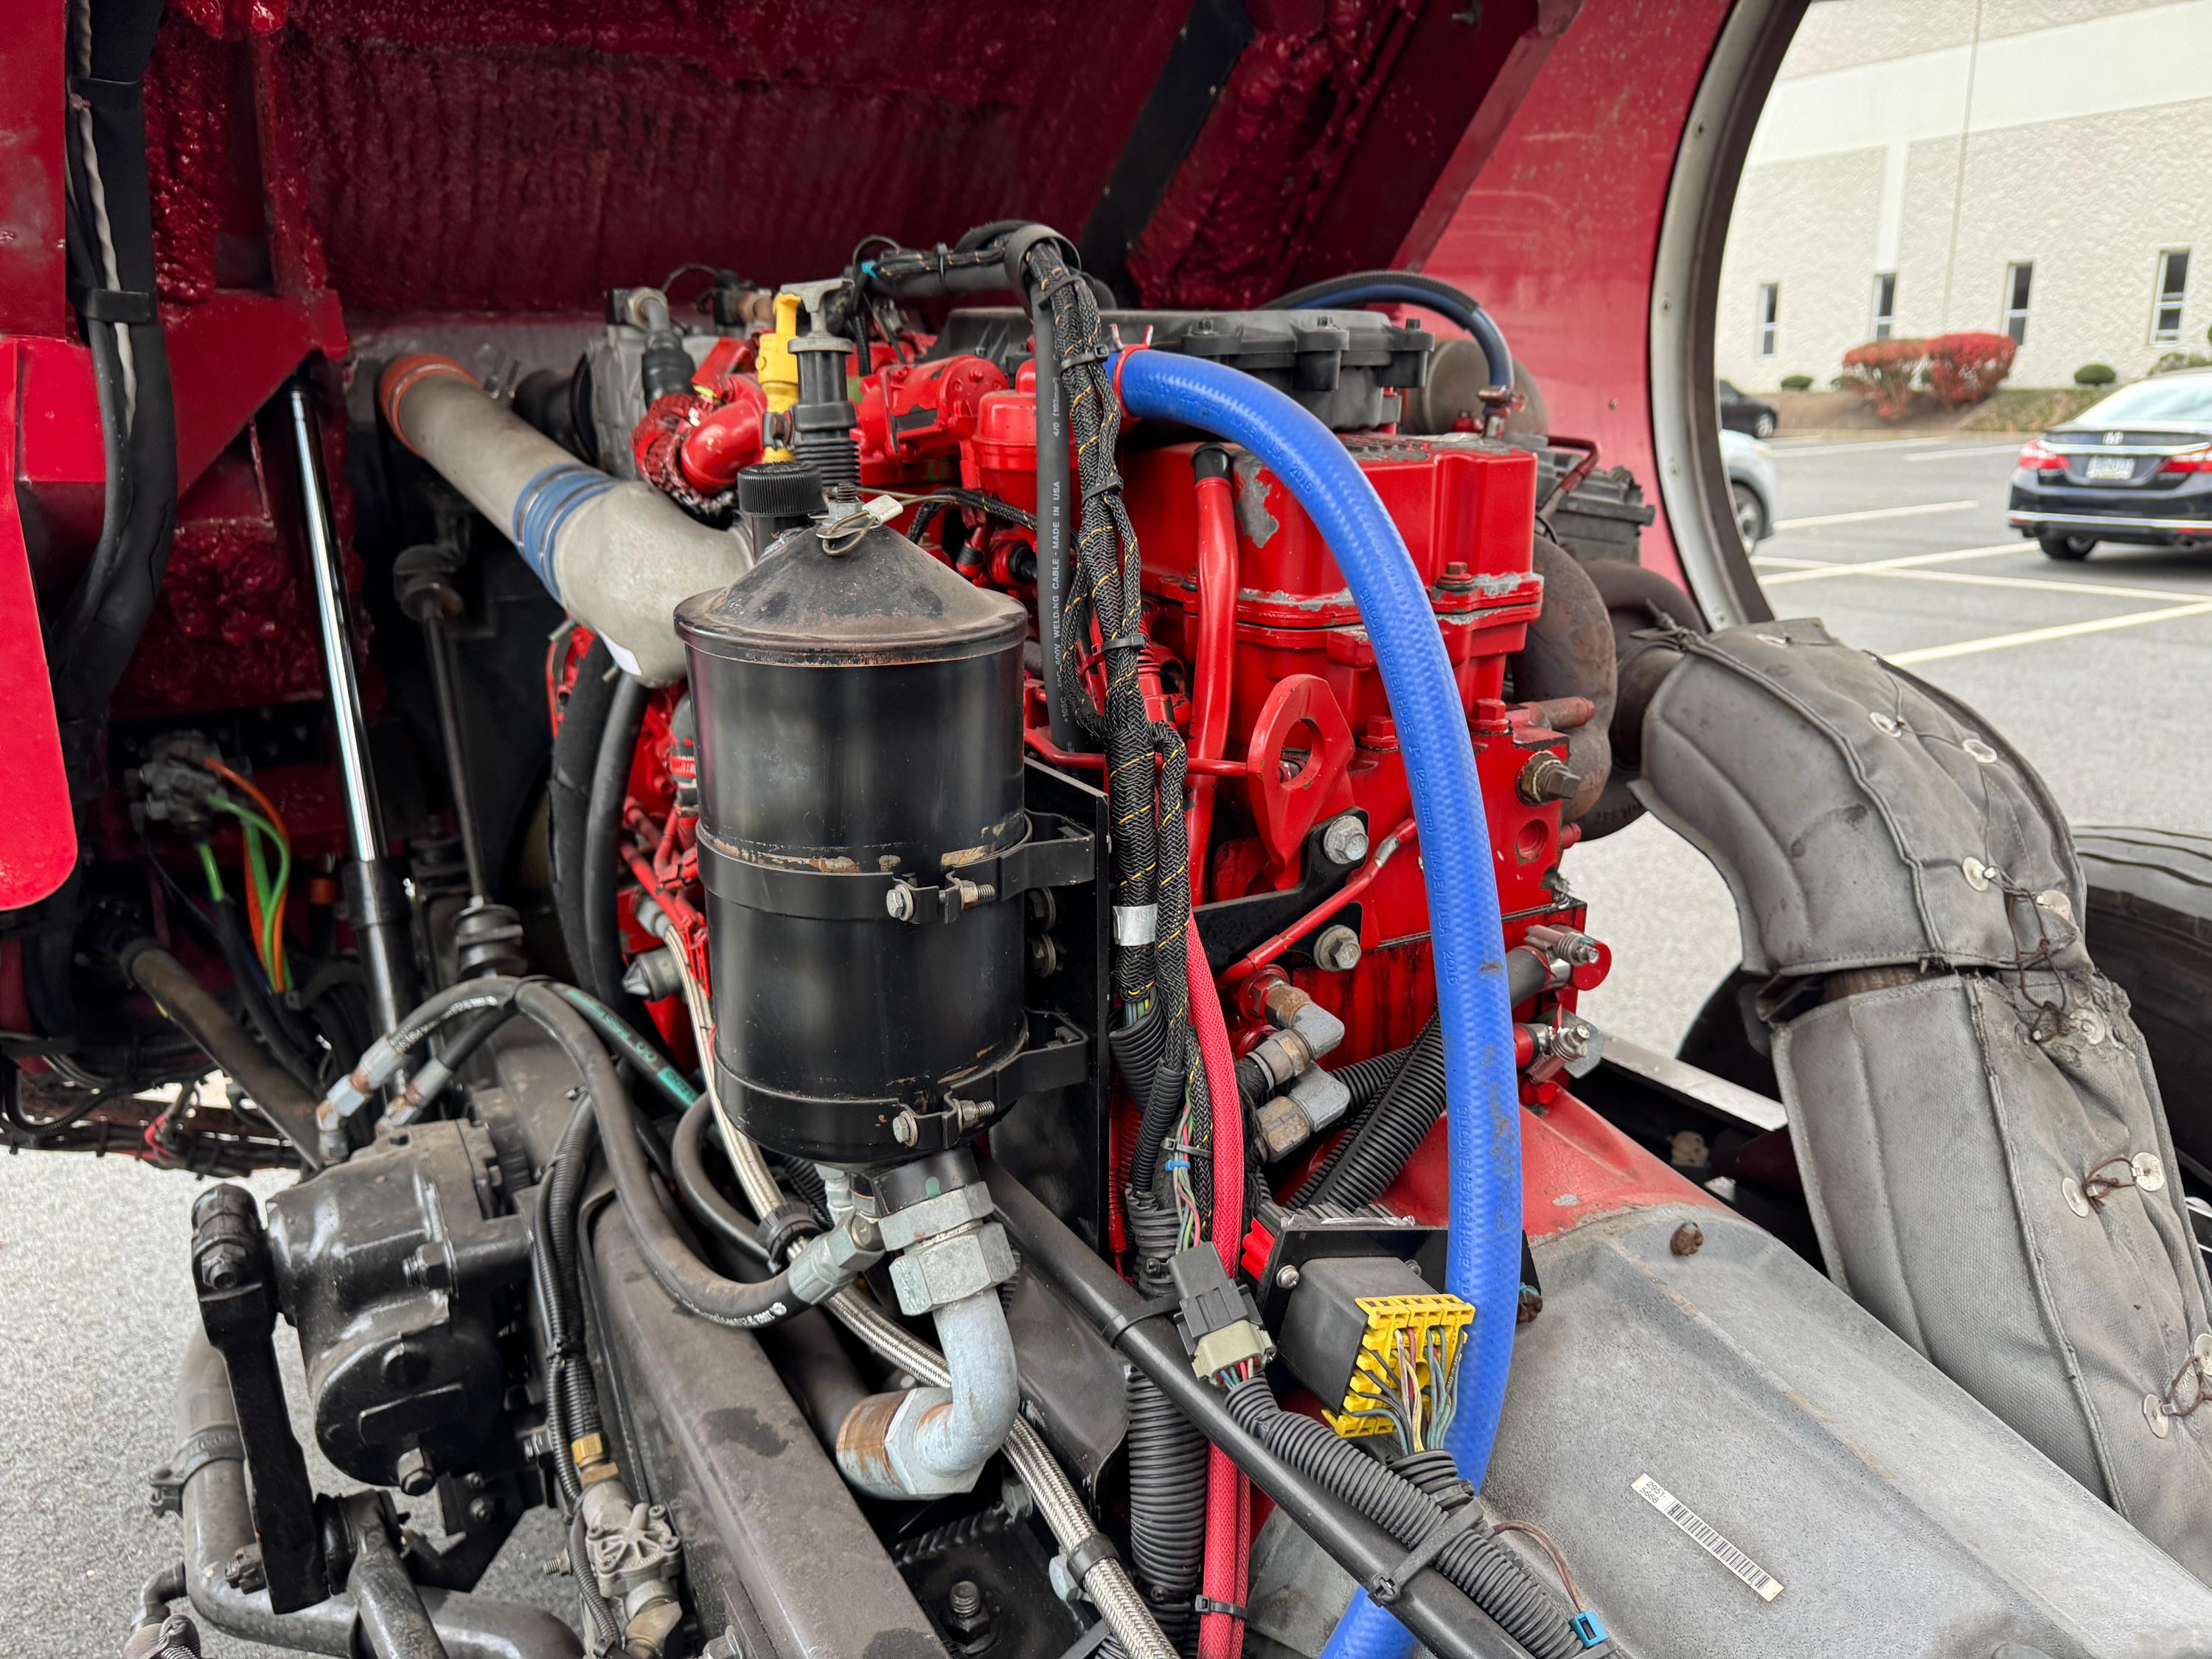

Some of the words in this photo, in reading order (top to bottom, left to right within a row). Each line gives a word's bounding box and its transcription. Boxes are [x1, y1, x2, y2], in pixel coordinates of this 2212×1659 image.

[1288, 463, 1313, 493] 2016
[1052, 507, 1060, 516] IN
[1359, 587, 1388, 646] SILICONE
[1381, 645, 1403, 697] HEATER
[1397, 698, 1416, 735] HOSE
[1430, 848, 1446, 889] MADE
[1435, 893, 1447, 906] IN
[1439, 908, 1452, 938] USA
[1443, 949, 1461, 986] 2016
